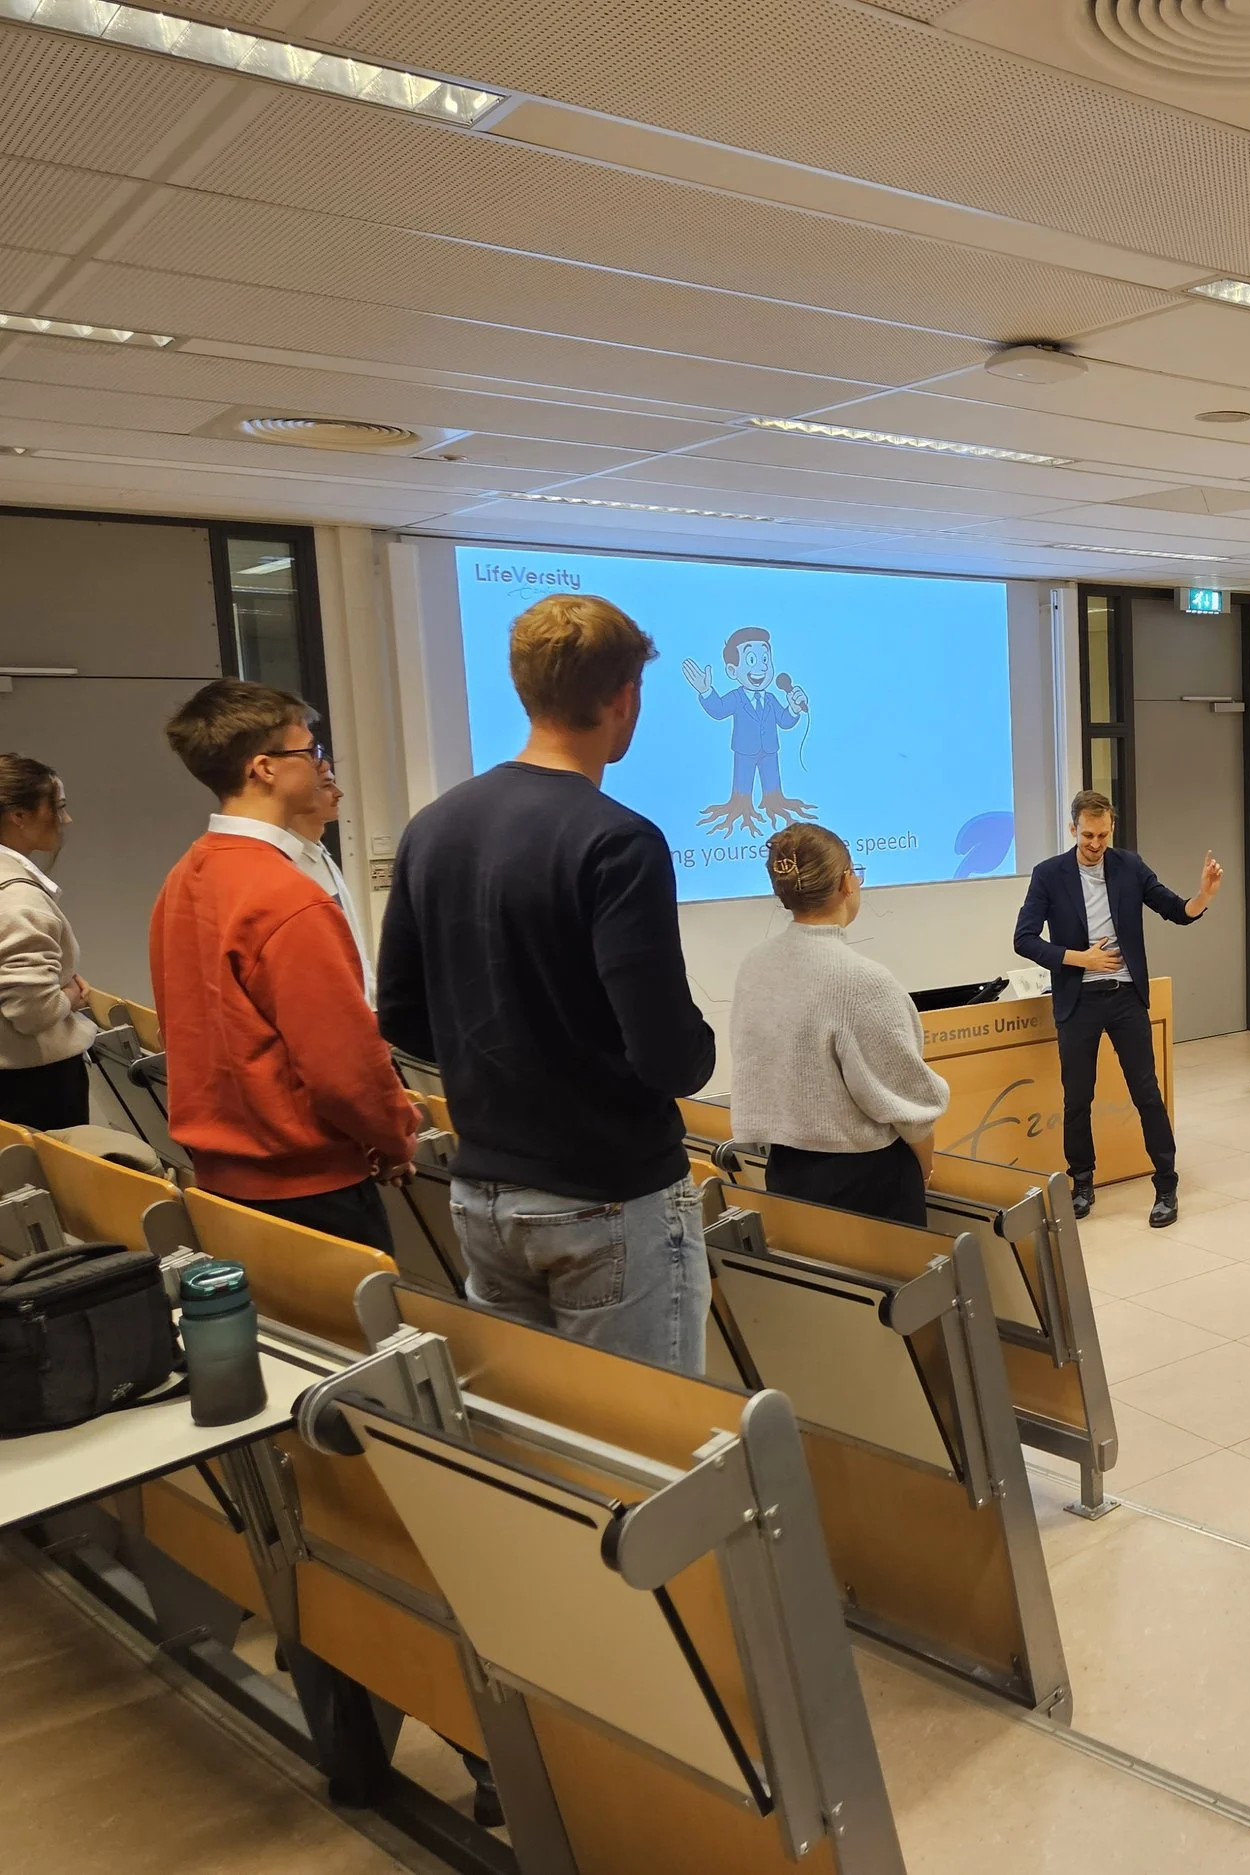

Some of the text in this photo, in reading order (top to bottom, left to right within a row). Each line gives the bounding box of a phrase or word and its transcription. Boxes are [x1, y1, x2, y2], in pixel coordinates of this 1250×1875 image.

[475, 563, 580, 590] LifeVersity
[701, 844, 769, 867] yourse
[856, 830, 917, 855] speech
[923, 1016, 1039, 1045] Erasmus Unive
